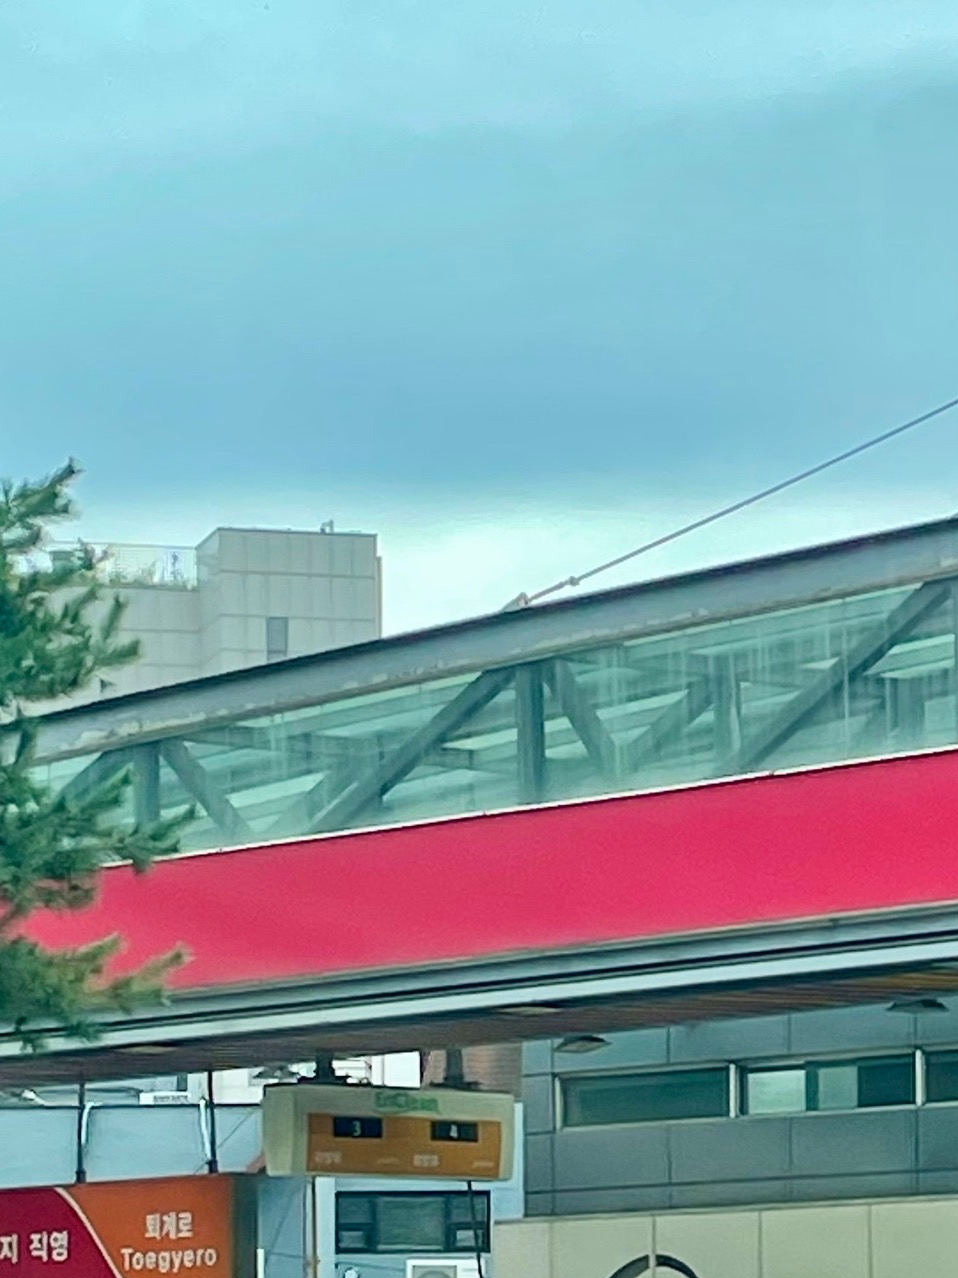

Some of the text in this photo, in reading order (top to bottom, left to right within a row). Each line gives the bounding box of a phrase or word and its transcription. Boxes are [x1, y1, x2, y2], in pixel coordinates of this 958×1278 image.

[352, 1121, 362, 1137] 3
[144, 1212, 194, 1240] 퇴계로
[29, 1231, 70, 1263] 직영
[121, 1247, 217, 1274] Toegyero
